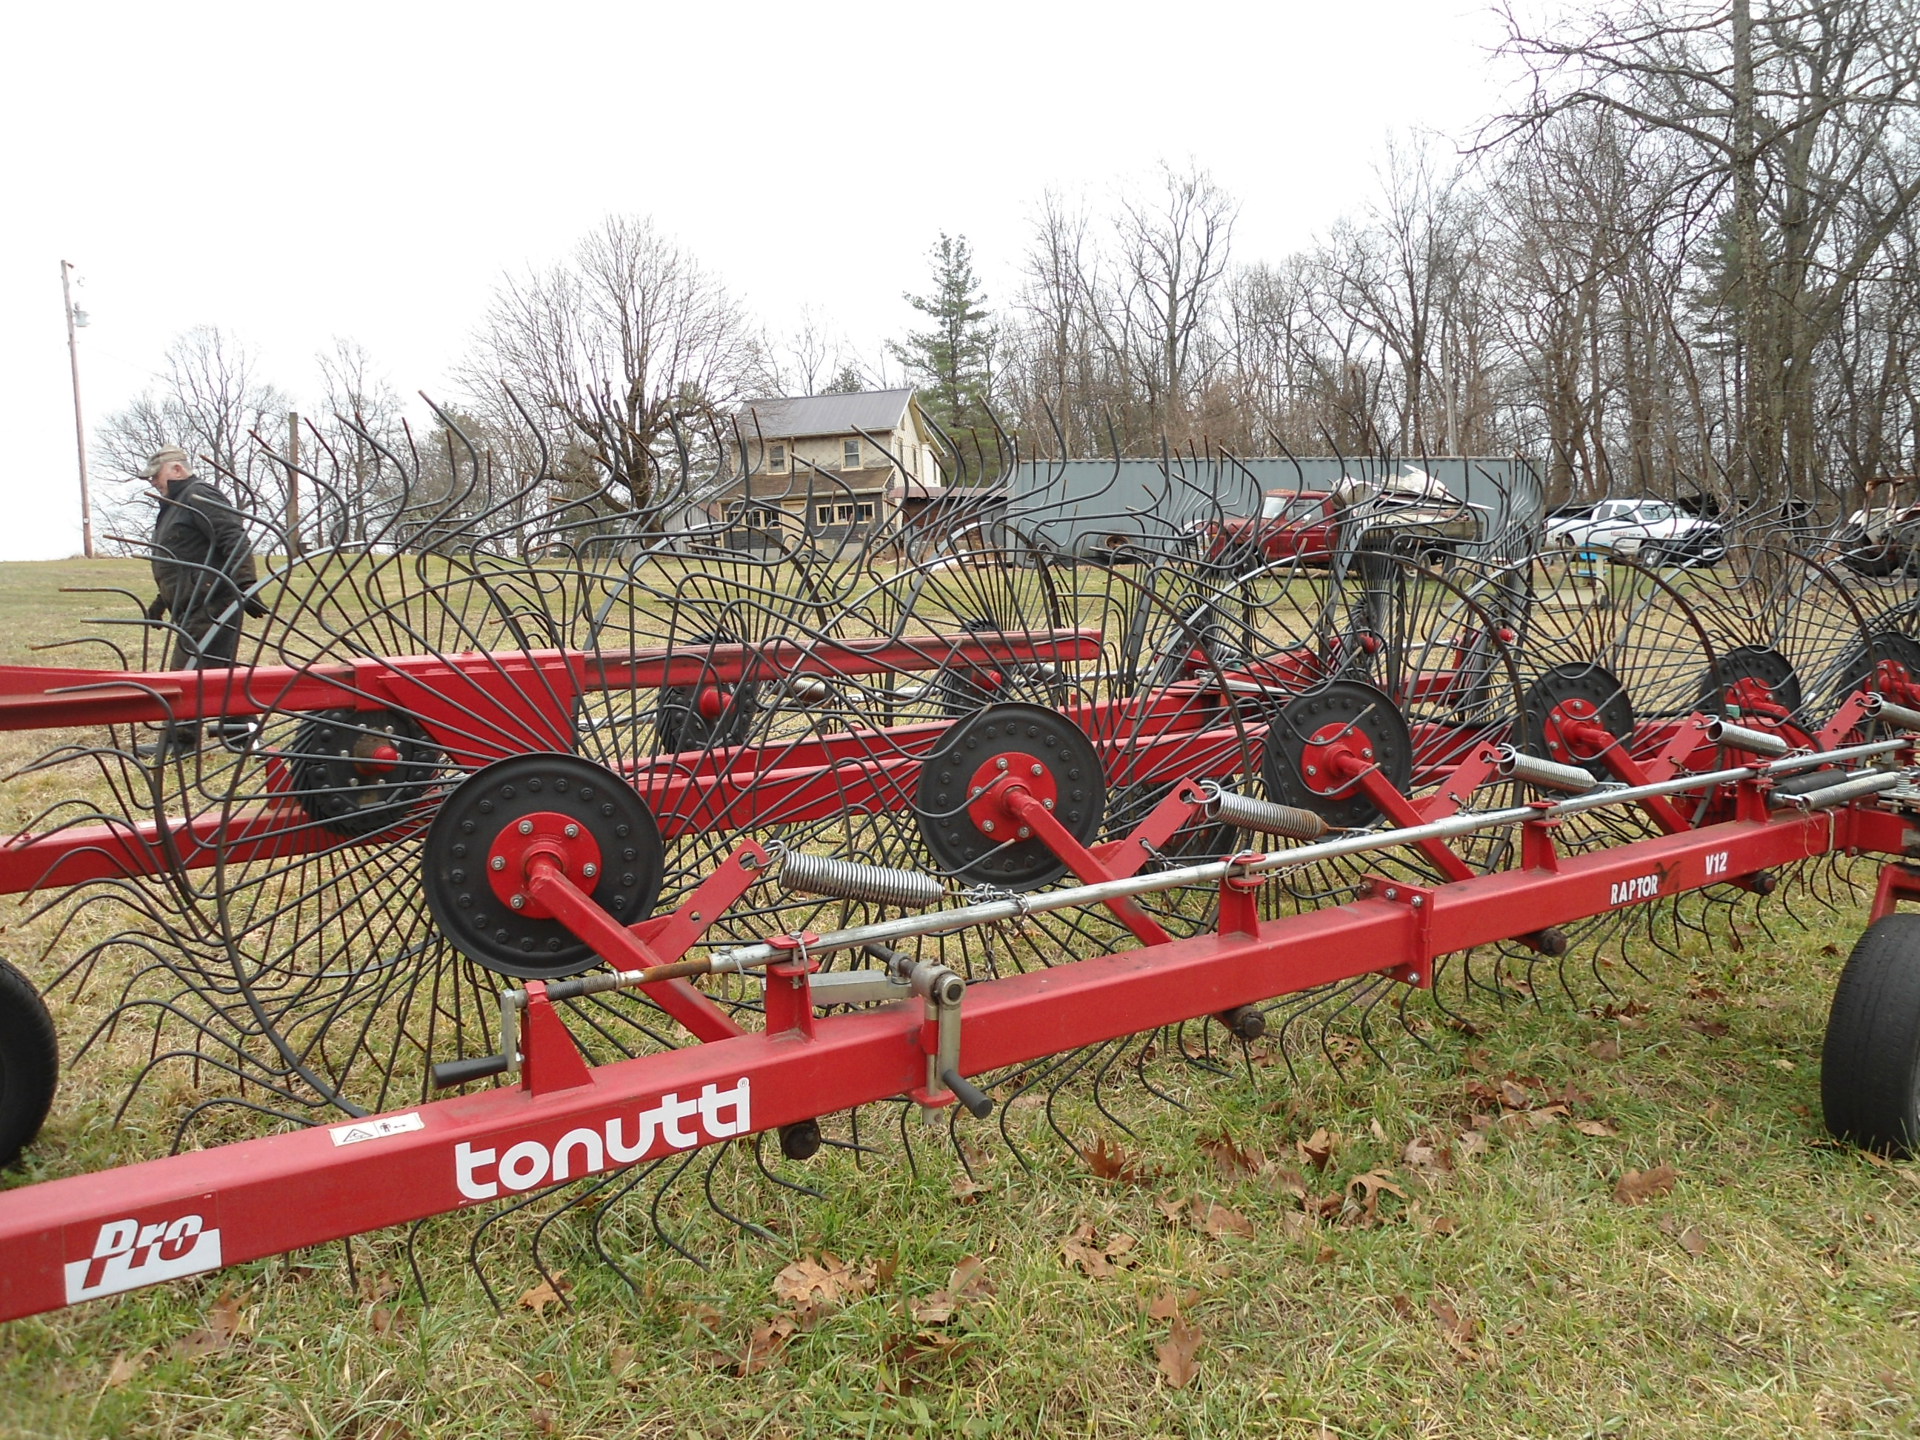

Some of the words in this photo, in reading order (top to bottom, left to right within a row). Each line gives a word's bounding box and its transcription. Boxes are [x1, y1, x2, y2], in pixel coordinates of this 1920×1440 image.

[1610, 874, 1658, 905] RAPTOR
[1705, 852, 1728, 875] V12
[455, 1077, 750, 1200] tonutti
[82, 1214, 203, 1290] Pro
